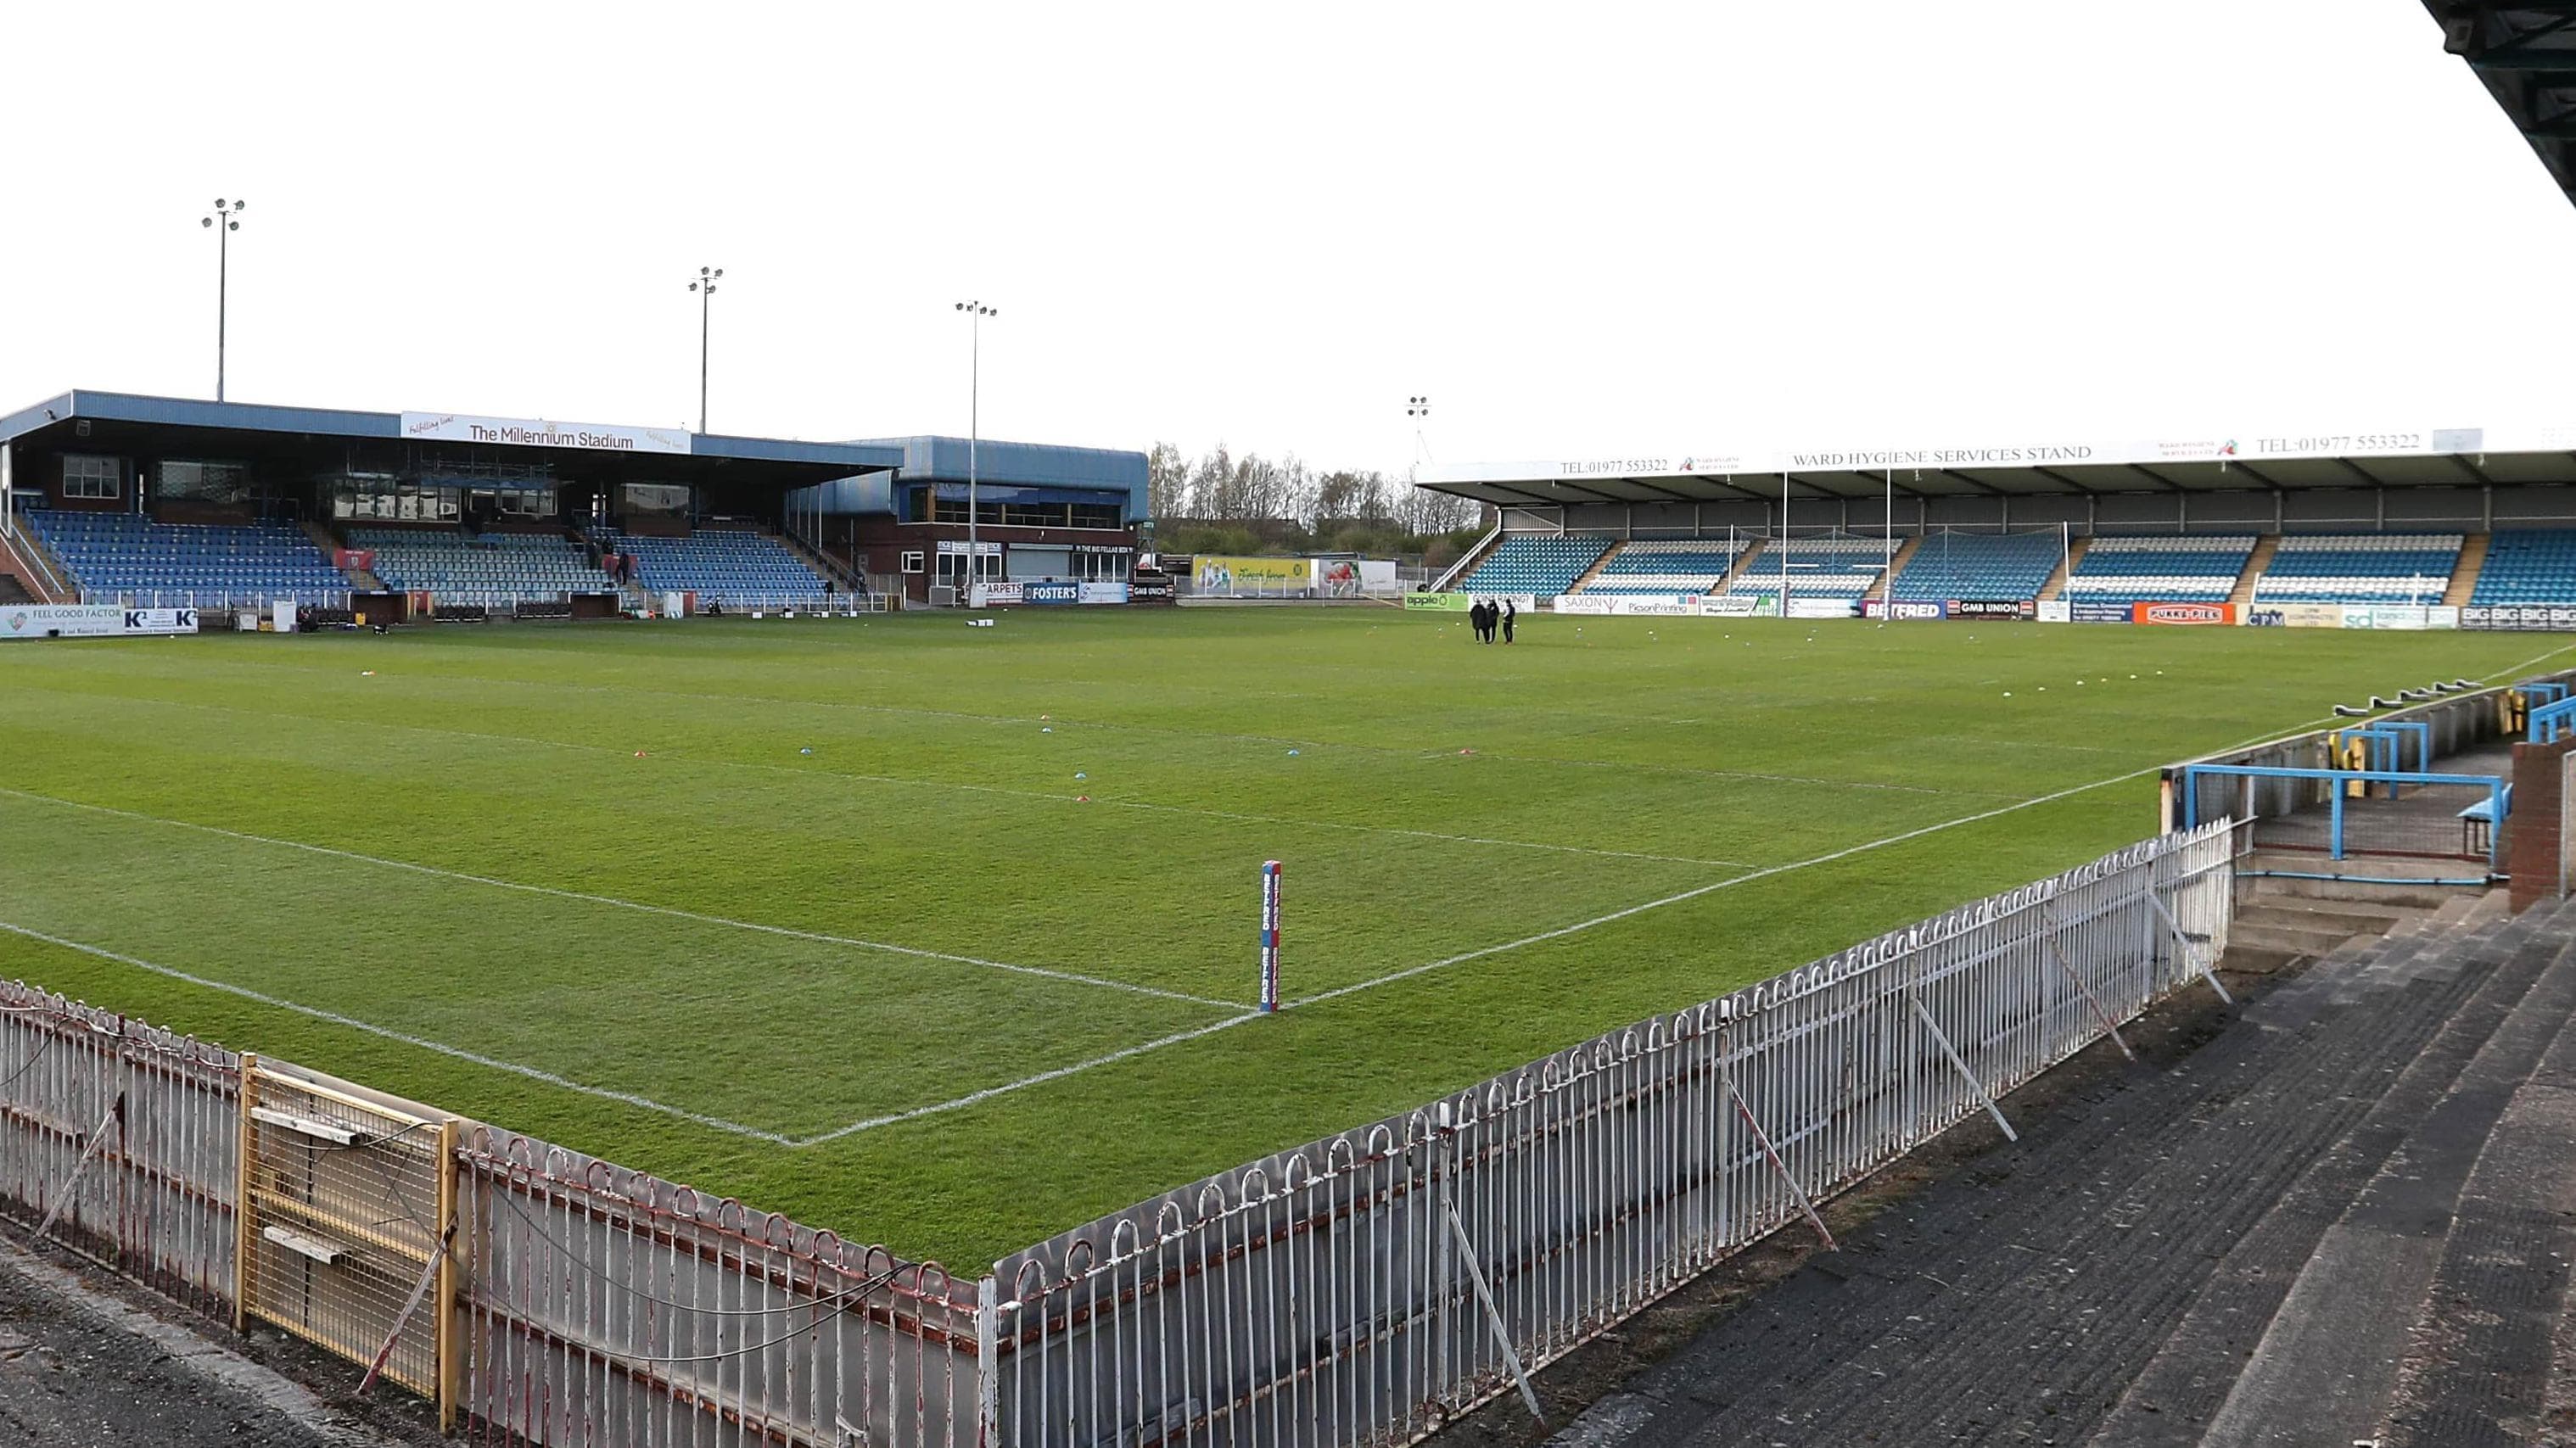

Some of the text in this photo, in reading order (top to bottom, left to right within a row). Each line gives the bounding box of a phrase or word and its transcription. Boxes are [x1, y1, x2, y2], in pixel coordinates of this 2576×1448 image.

[470, 425, 634, 450] The Millennium Stadium
[2256, 434, 2421, 454] TEL:01977 553322
[1794, 446, 2092, 467] WARD HYGIENE SERVICES STAND
[1560, 459, 1668, 474] TEL:01977 553322
[983, 583, 1023, 595] ARPETS
[1032, 586, 1078, 599] FOSTER'S
[1147, 587, 1167, 595] UNION
[1564, 596, 1602, 607] SAXON
[33, 608, 121, 618] FEEL GOOD FACTOR
[1867, 602, 1940, 618] BETFRED
[1961, 603, 2019, 613] GMB UNION
[2463, 608, 2489, 620] BIG
[2491, 608, 2519, 620] BIG
[2248, 614, 2285, 626] CPM
[2521, 609, 2549, 620] BIG
[2550, 609, 2576, 620] BIG
[1262, 873, 1271, 931] BETFRED
[1261, 947, 1269, 1004] BETFRED
